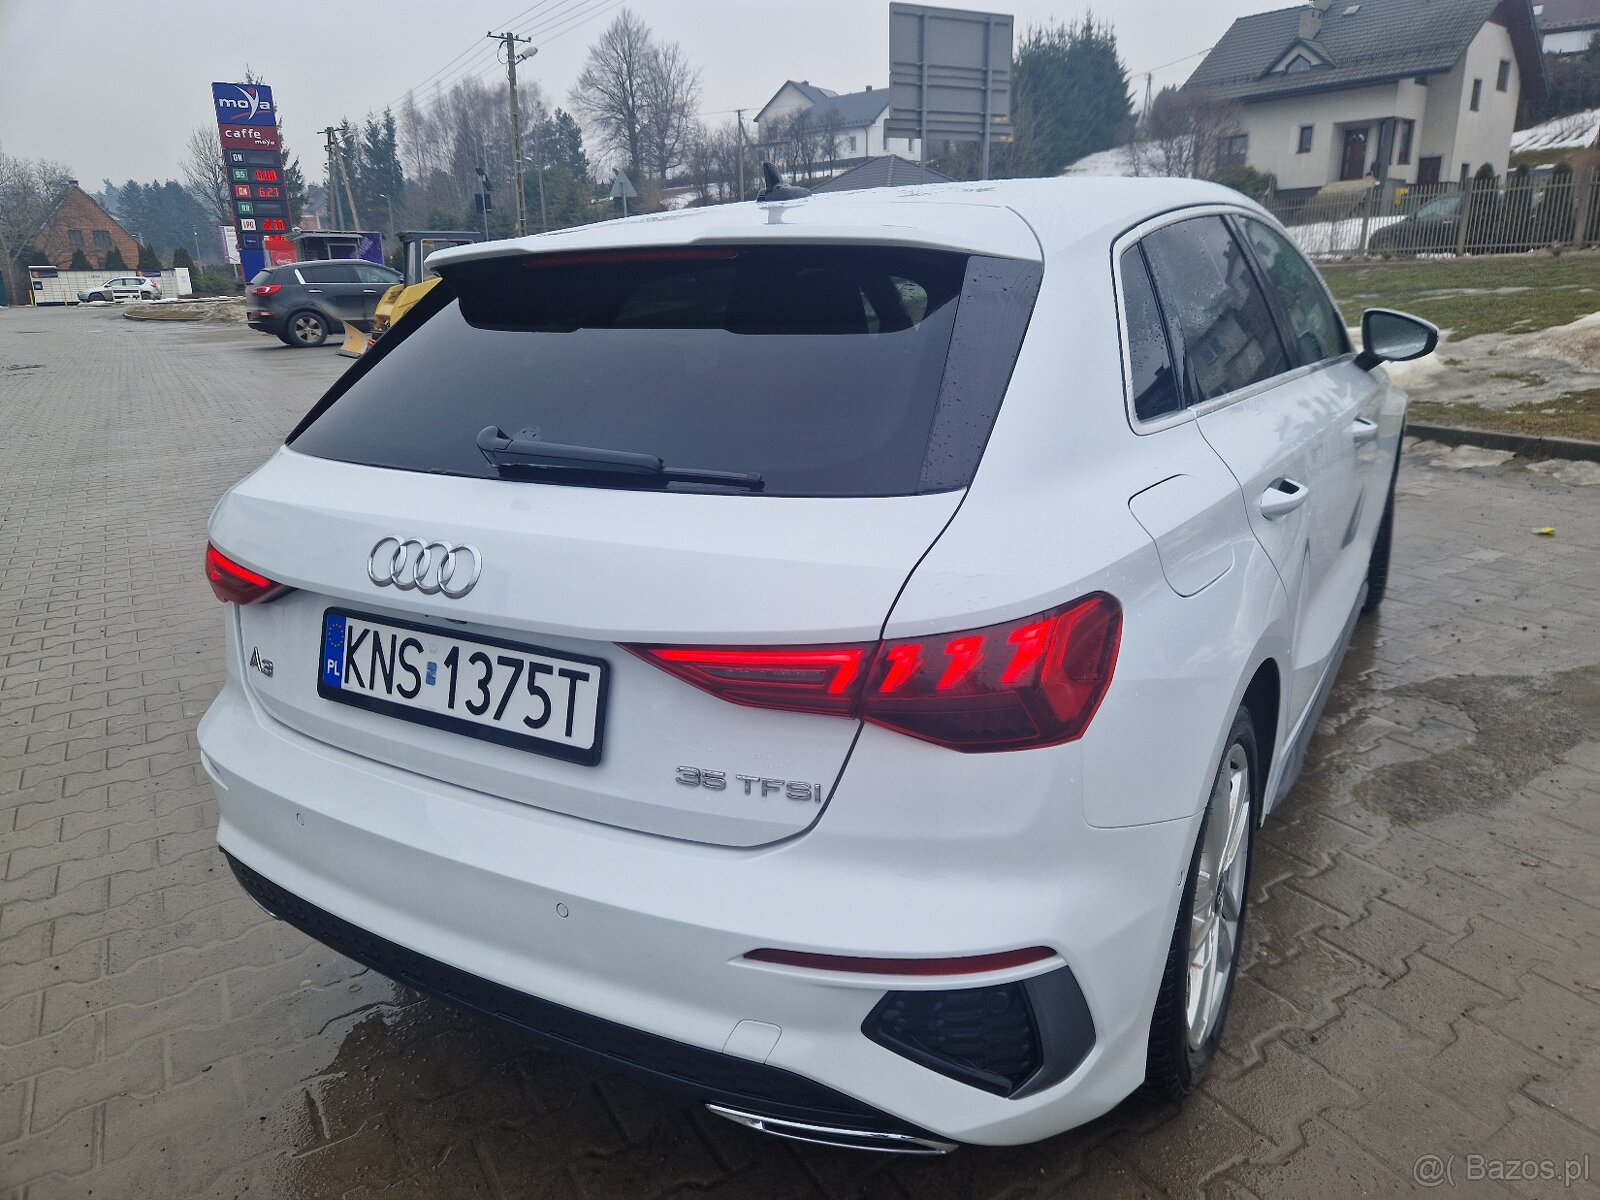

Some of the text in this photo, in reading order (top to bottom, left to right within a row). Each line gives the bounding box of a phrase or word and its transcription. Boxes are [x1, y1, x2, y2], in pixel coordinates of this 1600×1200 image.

[225, 128, 262, 139] caffe
[235, 170, 245, 179] 95
[250, 646, 274, 678] A3
[327, 659, 340, 676] PL
[344, 625, 590, 738] KNS 1375T
[675, 765, 821, 804] 35 TFSI
